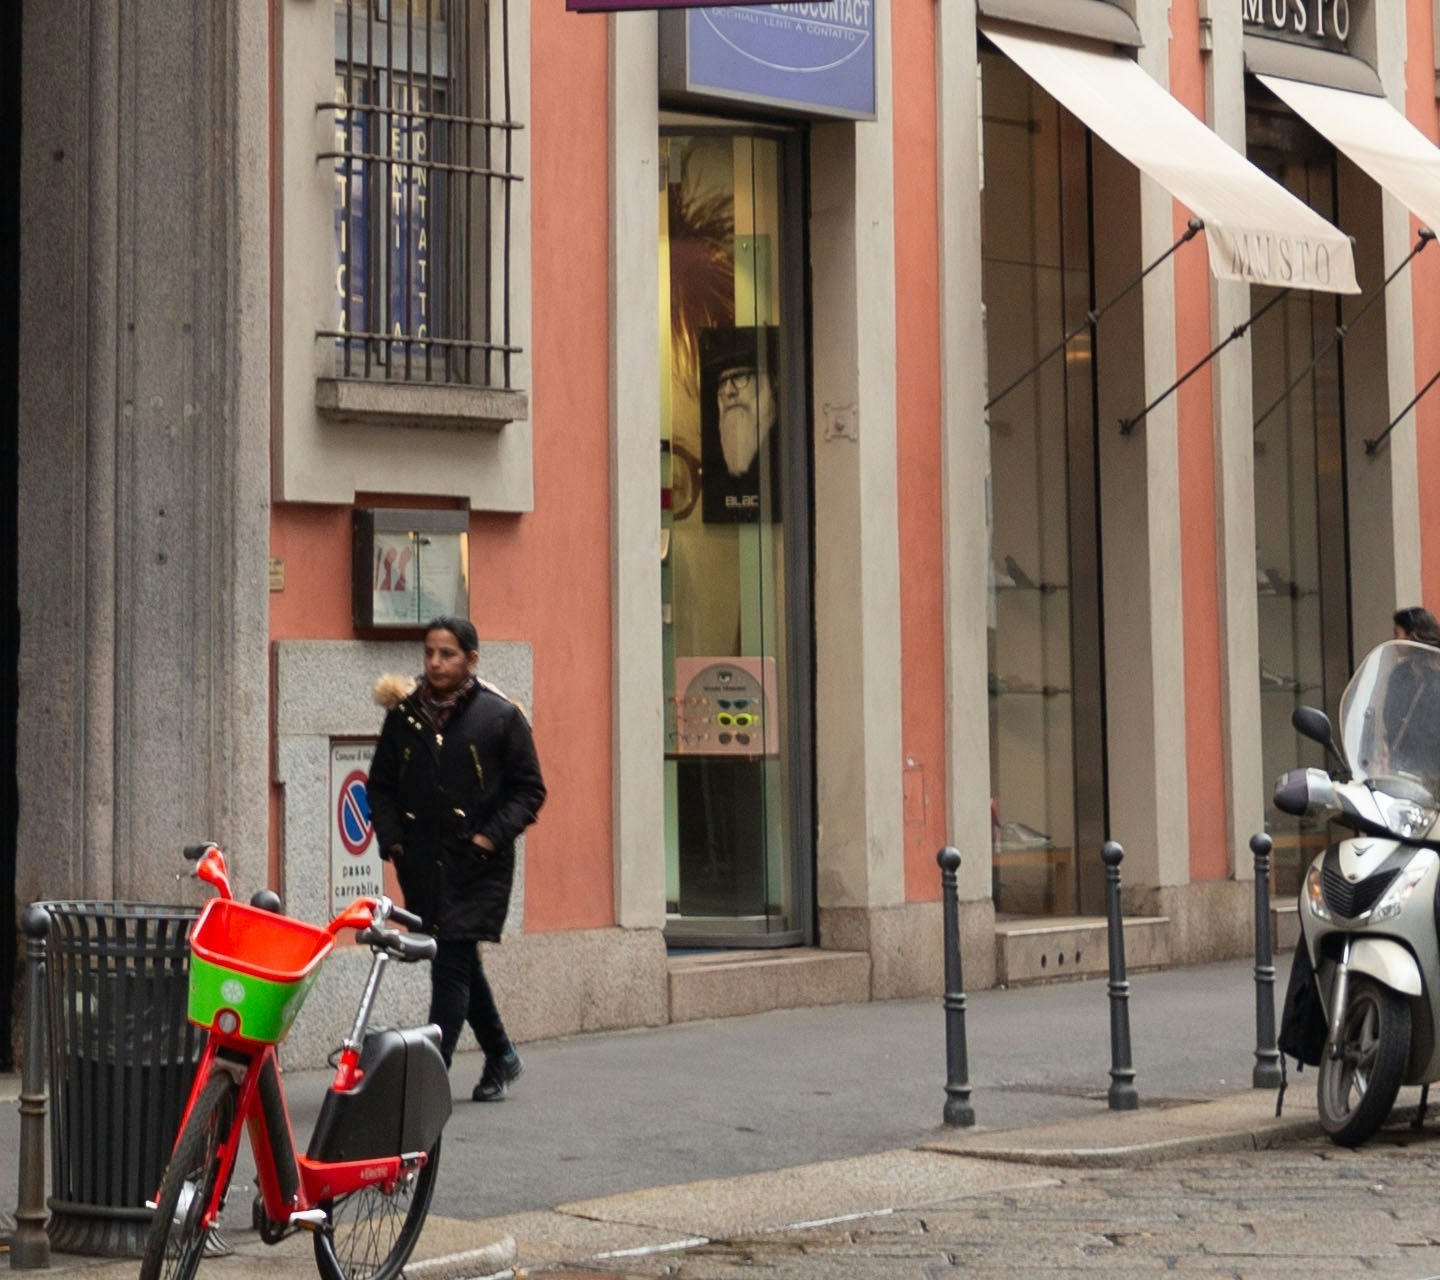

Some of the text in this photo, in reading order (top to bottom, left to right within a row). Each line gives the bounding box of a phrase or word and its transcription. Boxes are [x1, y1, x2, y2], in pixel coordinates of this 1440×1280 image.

[1231, 231, 1330, 285] MUSTO
[342, 865, 371, 878] passo
[334, 881, 380, 897] carrabile
